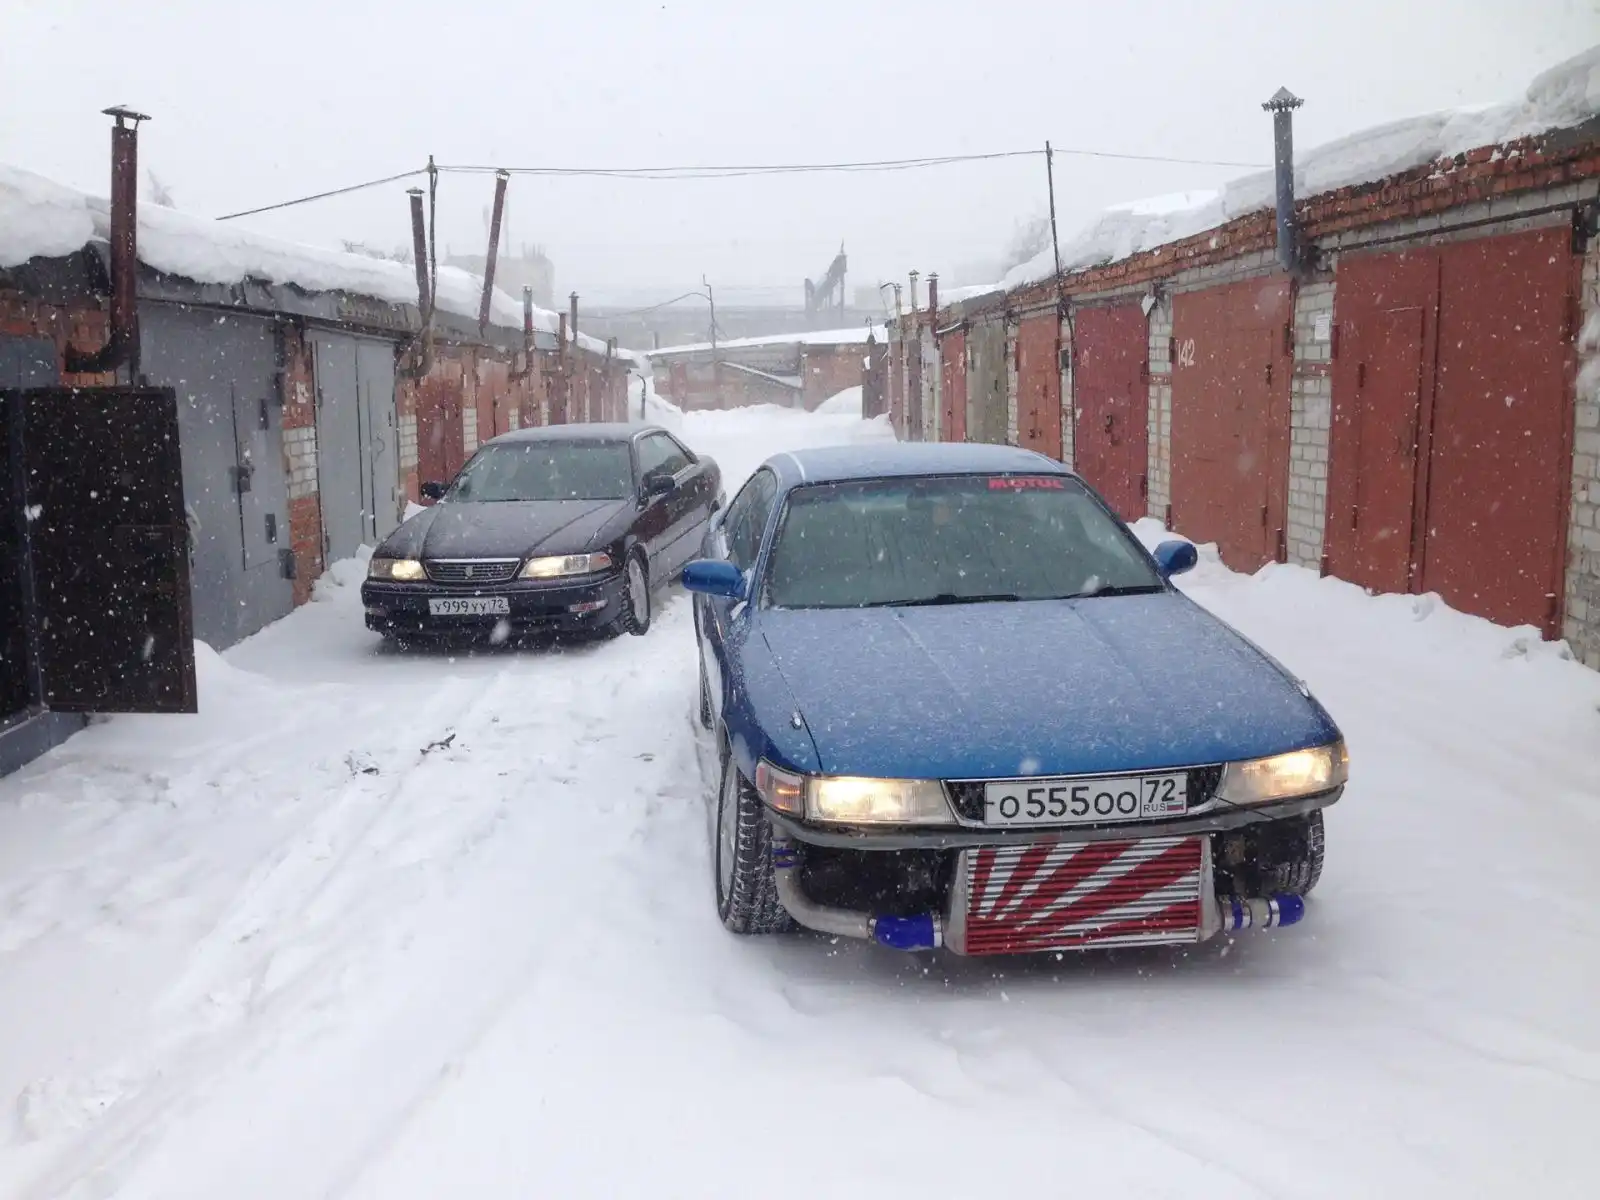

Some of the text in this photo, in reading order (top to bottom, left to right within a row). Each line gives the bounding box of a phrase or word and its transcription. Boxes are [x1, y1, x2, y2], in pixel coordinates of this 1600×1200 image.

[1177, 338, 1195, 368] 142
[1145, 779, 1176, 804] 72
[1143, 802, 1166, 813] RUS
